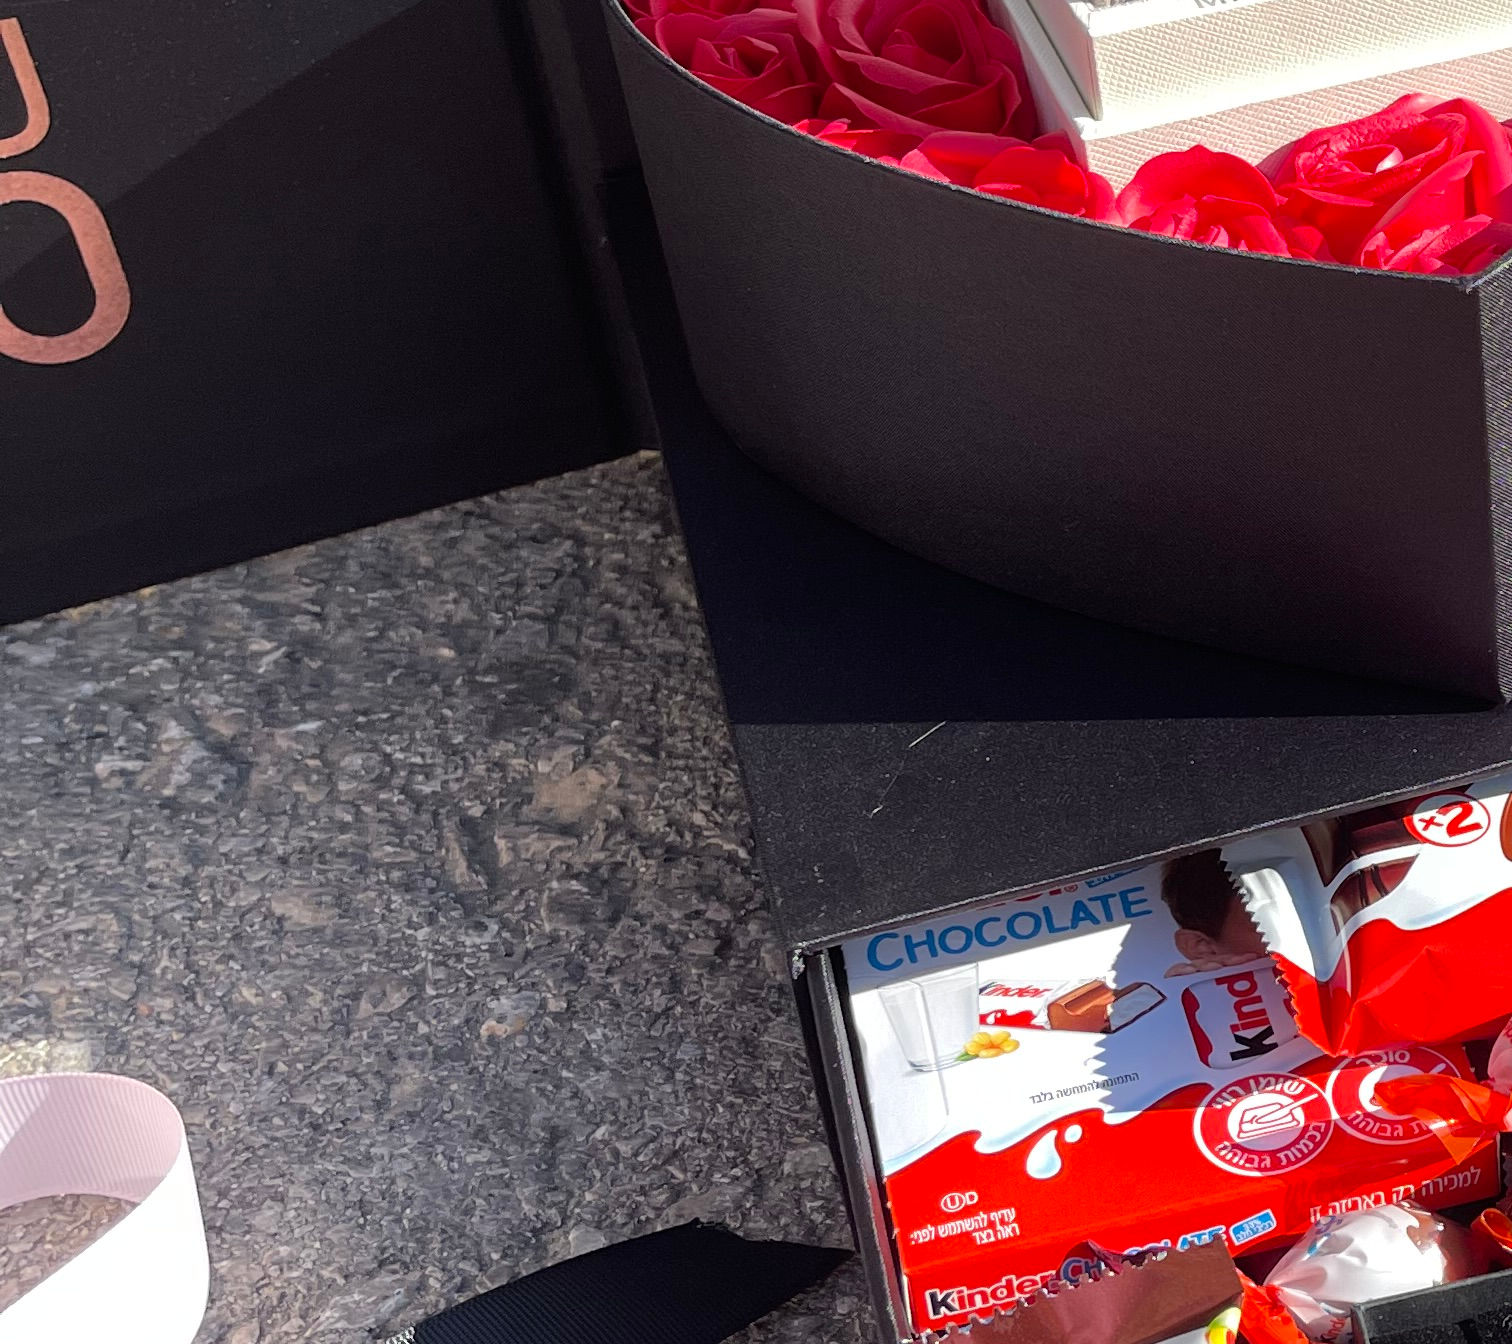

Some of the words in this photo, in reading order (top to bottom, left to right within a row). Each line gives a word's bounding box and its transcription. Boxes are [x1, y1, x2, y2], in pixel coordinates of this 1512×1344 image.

[866, 885, 1153, 971] CHOCOLATE
[1214, 1141, 1272, 1169] גבוהה
[1421, 1165, 1482, 1197] למכירה
[938, 1211, 988, 1238] להשתמש
[990, 1207, 1017, 1231] עדיף
[924, 1269, 1058, 1321] Kinder
